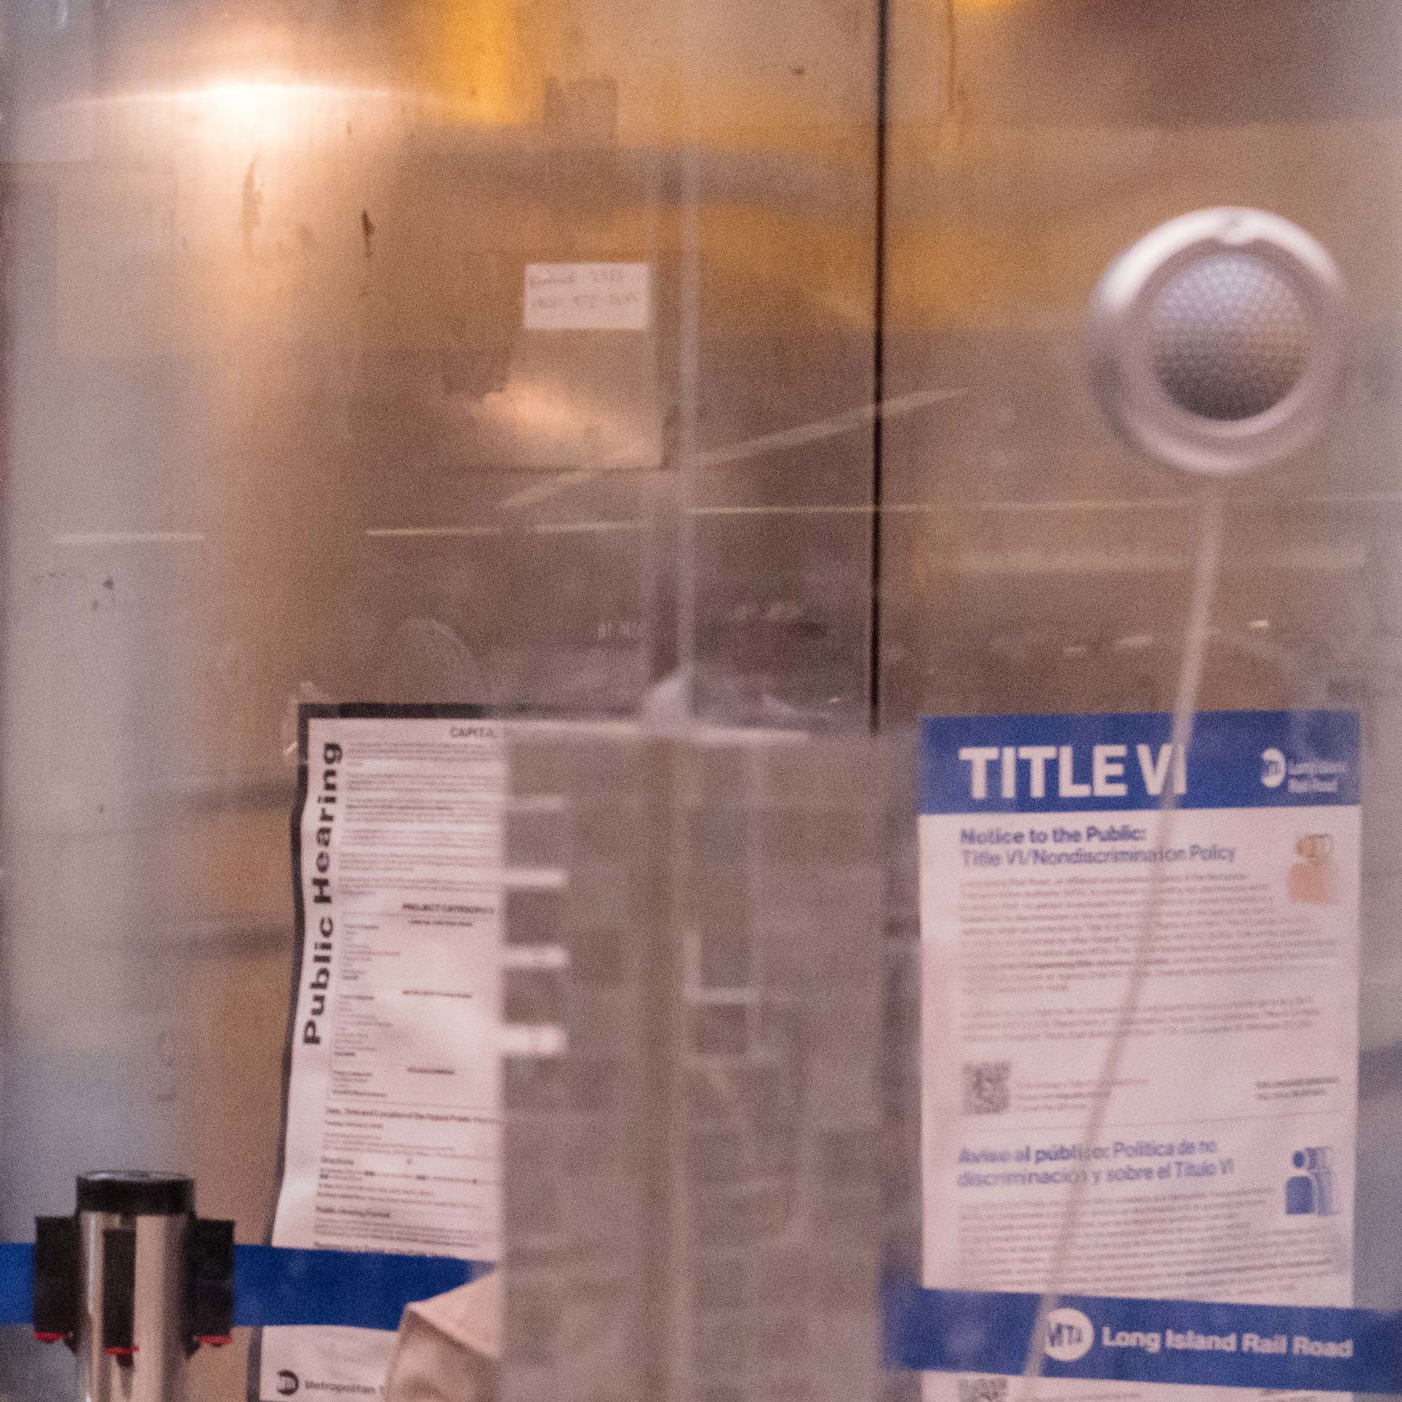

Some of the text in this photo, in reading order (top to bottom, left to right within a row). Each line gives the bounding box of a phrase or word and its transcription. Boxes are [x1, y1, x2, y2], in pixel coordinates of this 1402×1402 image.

[958, 743, 1187, 798] TITLE VI
[961, 825, 1146, 844] Notice to the Public:
[962, 849, 1000, 866] Title
[1189, 844, 1235, 863] Policy
[303, 742, 343, 1045] Public Hearing
[959, 1147, 1010, 1163] Aviso
[1014, 1145, 1030, 1162] al
[1177, 1140, 1195, 1155] de
[1198, 1140, 1216, 1153] no
[1107, 1164, 1153, 1181] sobre
[1157, 1162, 1171, 1179] el
[1219, 1157, 1234, 1175] VI
[1101, 1325, 1162, 1353] Long
[1165, 1328, 1237, 1352] Island
[1241, 1332, 1288, 1355] Rail
[1292, 1335, 1354, 1359] Road
